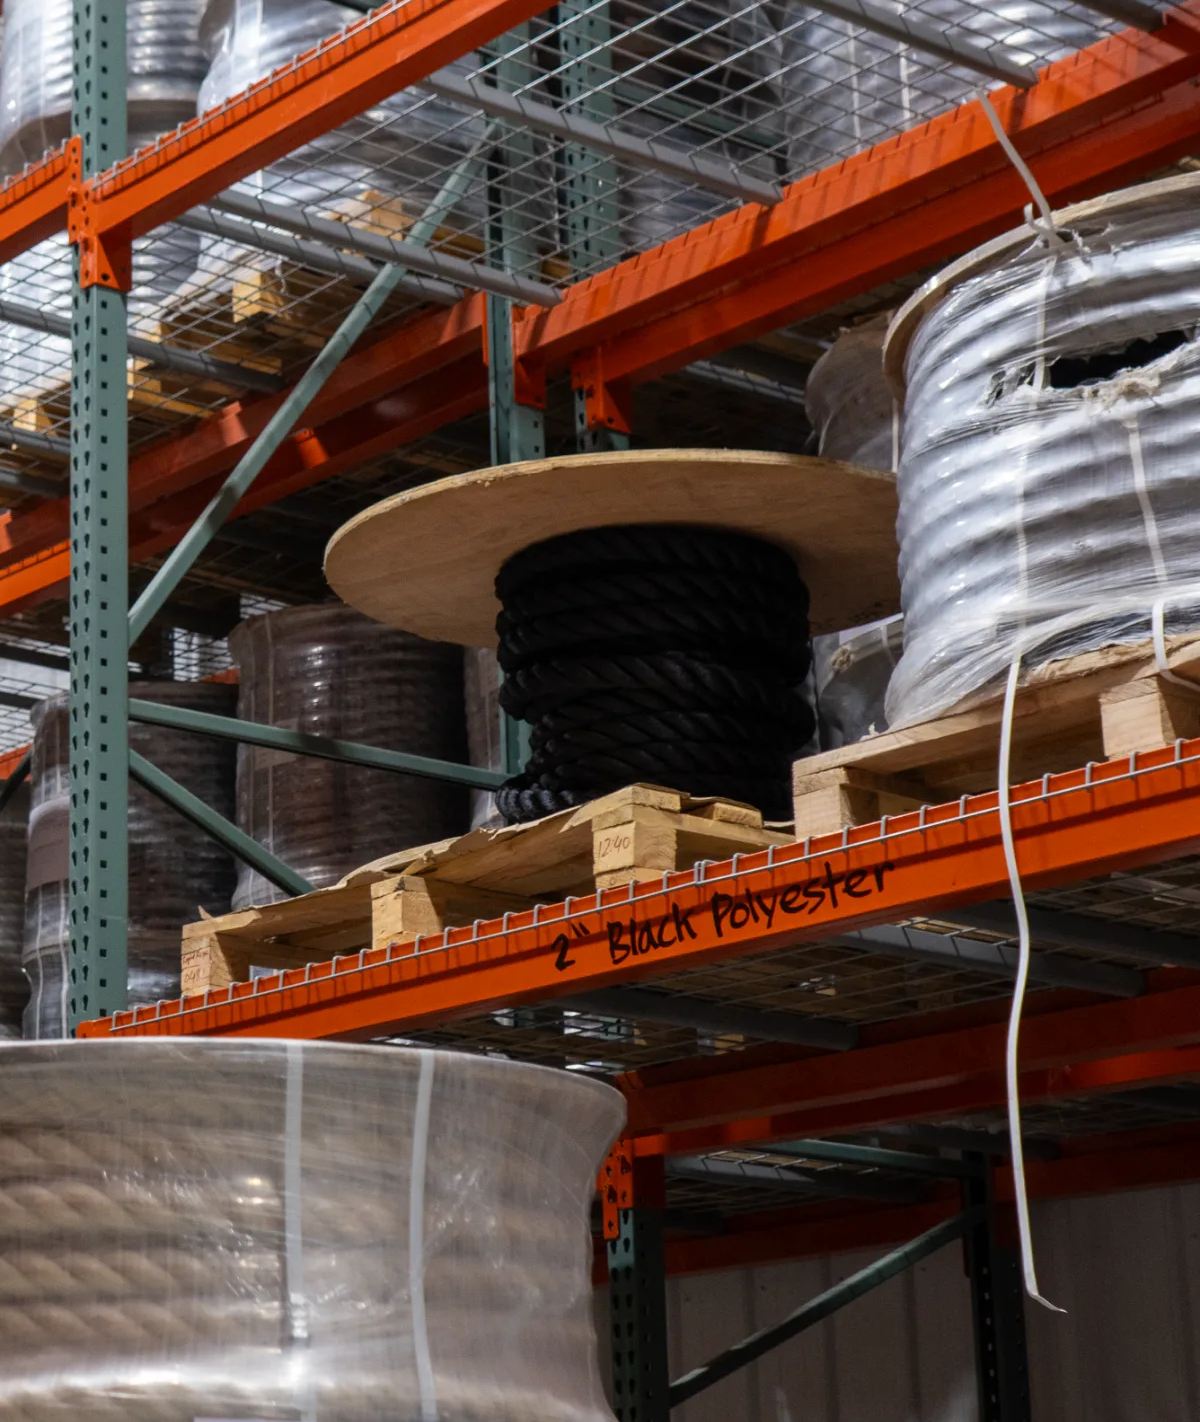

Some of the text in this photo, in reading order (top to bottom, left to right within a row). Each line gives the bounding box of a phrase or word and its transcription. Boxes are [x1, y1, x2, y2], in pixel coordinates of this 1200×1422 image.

[597, 835, 630, 860] 12:40
[550, 861, 895, 971] 2" Black Polyester
